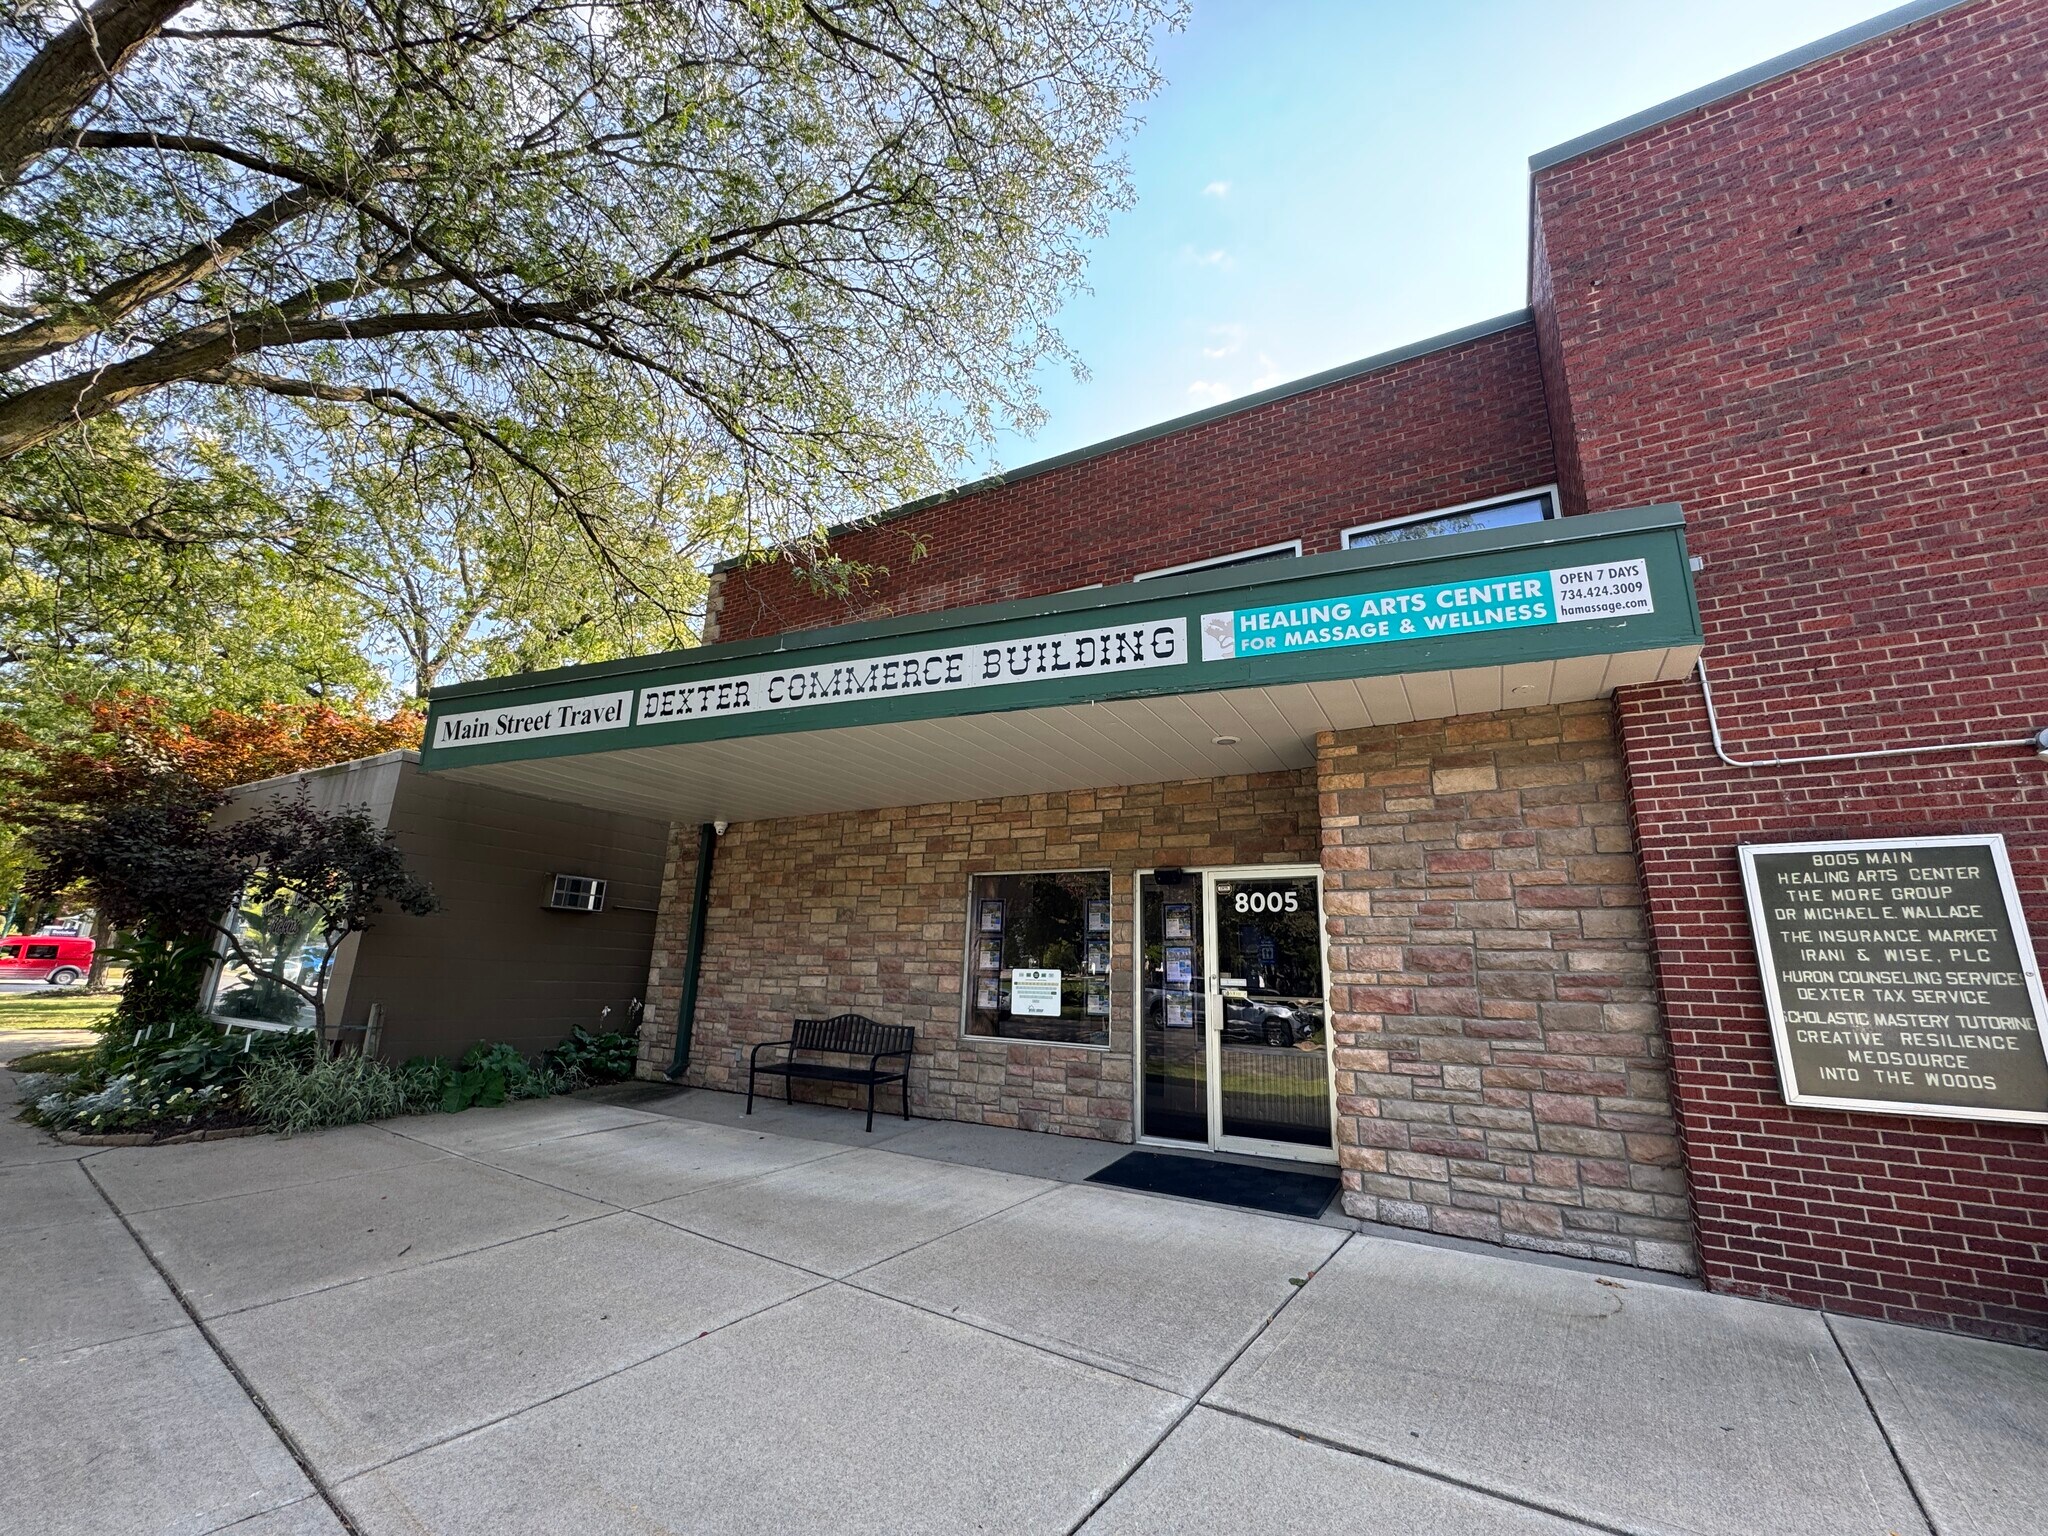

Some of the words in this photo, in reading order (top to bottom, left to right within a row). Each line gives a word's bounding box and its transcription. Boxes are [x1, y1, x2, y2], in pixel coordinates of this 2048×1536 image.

[1559, 569, 1594, 585] OPEN
[1597, 569, 1604, 580] 7
[1608, 565, 1640, 578] DAYS
[1560, 581, 1644, 601] 734.424.3009
[1240, 602, 1352, 633] HEALING
[1360, 593, 1427, 618] ARTS
[1436, 579, 1544, 608] CENTER
[1561, 599, 1649, 616] hamassage.com
[1241, 637, 1277, 651] FOR
[1284, 621, 1390, 647] MASSAGE
[1399, 618, 1417, 634] &
[1423, 602, 1548, 631] WELLNESS
[644, 680, 751, 719] DEXTER
[767, 653, 965, 703] COMMERCE
[982, 626, 1176, 680] BUILDING
[441, 712, 490, 742] Main
[495, 711, 553, 736] Street
[557, 699, 623, 728] Travel
[1812, 853, 1860, 867] 8005
[1866, 851, 1913, 865] MAIN
[1777, 870, 1850, 885] HEALING
[1857, 868, 1898, 882] ARTS
[1908, 866, 1980, 881] CENTER
[1234, 891, 1299, 914] 8005
[1786, 889, 1824, 902] THE
[1831, 888, 1883, 901] MORE
[1891, 886, 1952, 900] GROUP
[1774, 908, 1797, 921] DR
[1803, 907, 1880, 920] MICHAEL
[1882, 906, 1898, 919] E.
[1901, 905, 1983, 920] WALLACE
[1780, 931, 1813, 943] THE
[1818, 929, 1921, 943] INSURANCE
[1927, 928, 1999, 943] MARKET
[1800, 949, 1845, 962] IRANI
[1857, 949, 1870, 962] &
[1950, 949, 1991, 963] PLC
[1782, 971, 1833, 984] HURON
[1839, 971, 1942, 985] COUNSELING
[1797, 988, 1865, 1002] DEXTER
[1872, 989, 1906, 1002] TAX
[1913, 990, 1991, 1005] SERVICE
[1874, 1013, 1950, 1029] MASTERY
[1796, 1030, 1882, 1046] CREATIVE
[1901, 1033, 2020, 1051] RESILIENCE
[1848, 1050, 1969, 1070] MEDSOURCE
[1820, 1067, 1859, 1082] INTO
[1873, 1070, 1914, 1085] THE
[1924, 1073, 1997, 1090] WOODS
